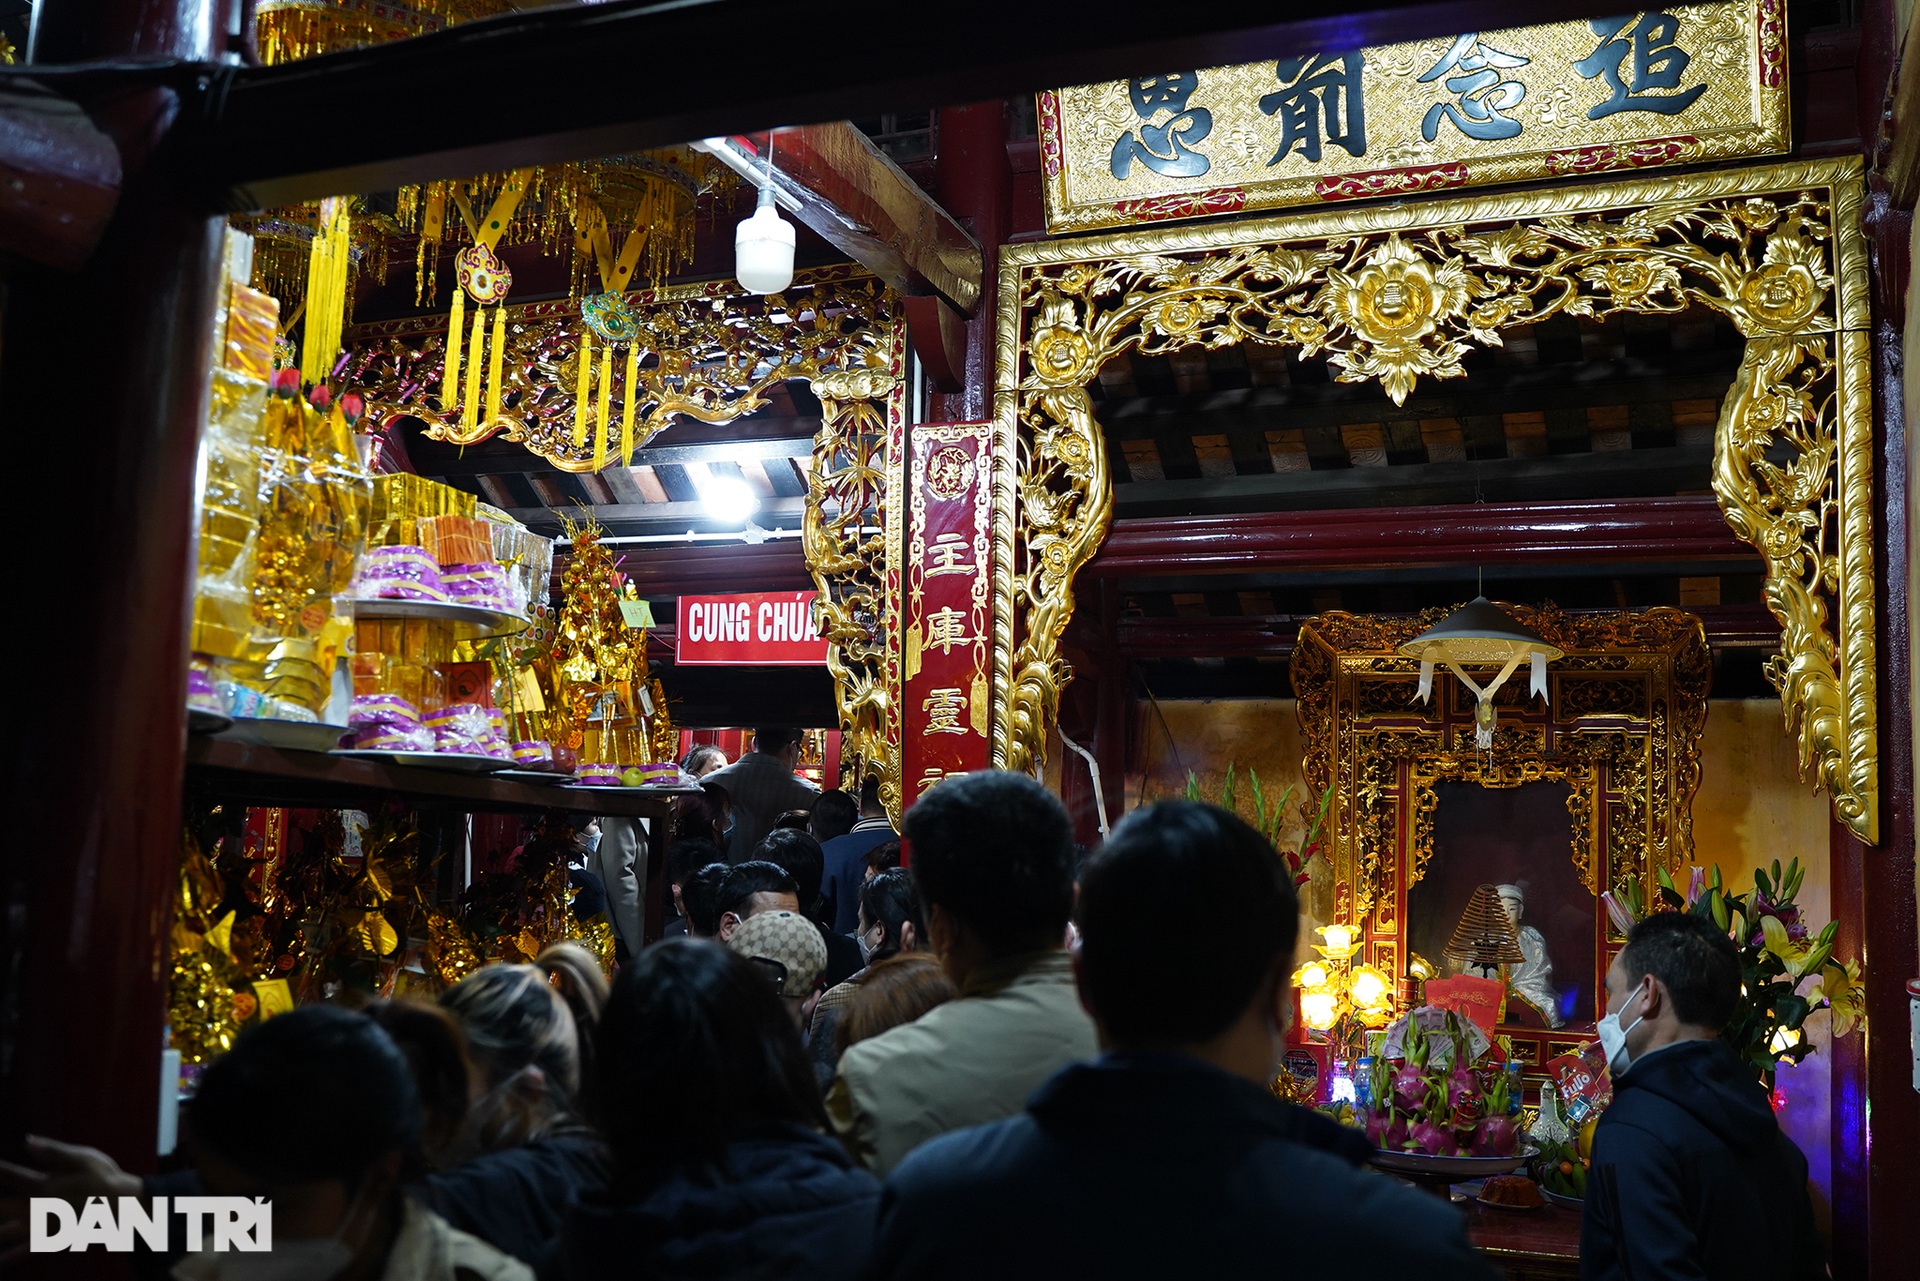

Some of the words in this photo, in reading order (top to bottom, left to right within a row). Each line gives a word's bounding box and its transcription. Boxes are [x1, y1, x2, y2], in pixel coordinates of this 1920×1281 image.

[688, 602, 751, 642] CUNG
[757, 592, 821, 642] CHÚA
[1560, 1073, 1591, 1100] Fullo
